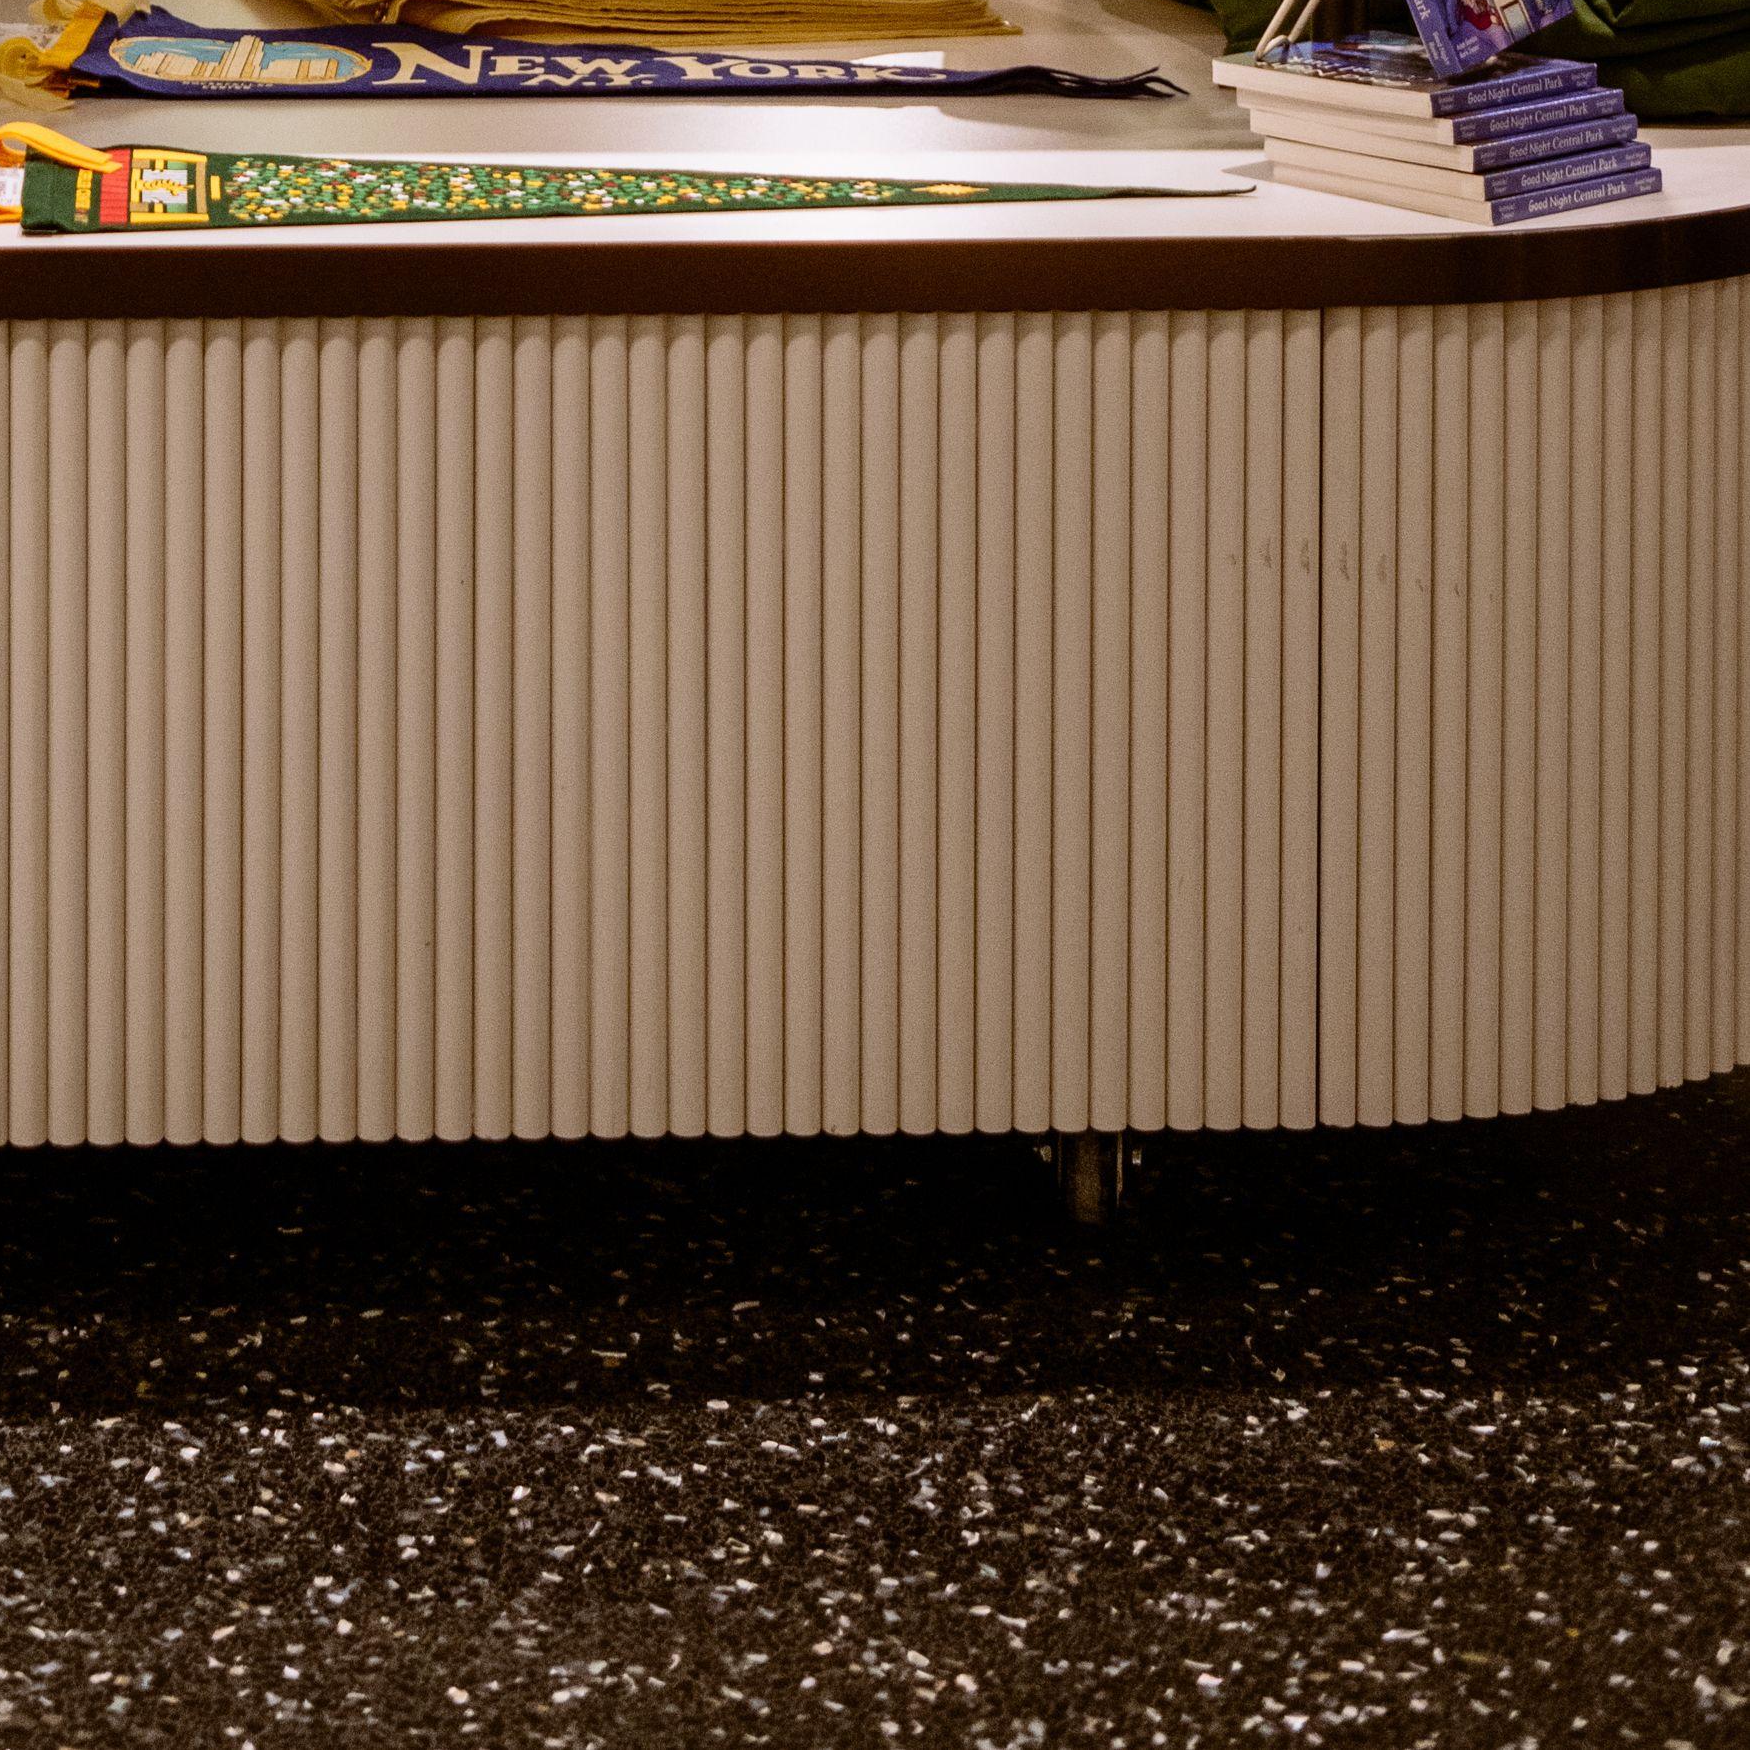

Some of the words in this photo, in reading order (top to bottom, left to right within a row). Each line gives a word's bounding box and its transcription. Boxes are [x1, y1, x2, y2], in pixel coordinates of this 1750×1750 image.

[370, 42, 643, 86] NEW
[652, 54, 947, 81] YORK
[519, 73, 658, 87] N.Y.
[1467, 88, 1488, 103] Good
[1488, 85, 1510, 102] Night
[1511, 81, 1543, 97] Central
[1544, 77, 1563, 92] Park
[1489, 118, 1510, 132] Good
[1510, 114, 1533, 130] Night
[1534, 108, 1568, 124] Central
[1569, 102, 1588, 118] Park
[1509, 145, 1528, 158] Good
[1528, 141, 1551, 157] Night
[1552, 134, 1585, 150] Central
[1585, 129, 1603, 144] Park
[1521, 173, 1540, 186] Good
[1542, 168, 1563, 185] Night
[1565, 162, 1598, 179] Central
[1599, 157, 1618, 172] Park
[1528, 197, 1549, 212] Good
[1549, 193, 1572, 209] Night
[1574, 186, 1607, 203] Central
[1607, 181, 1627, 196] Park
